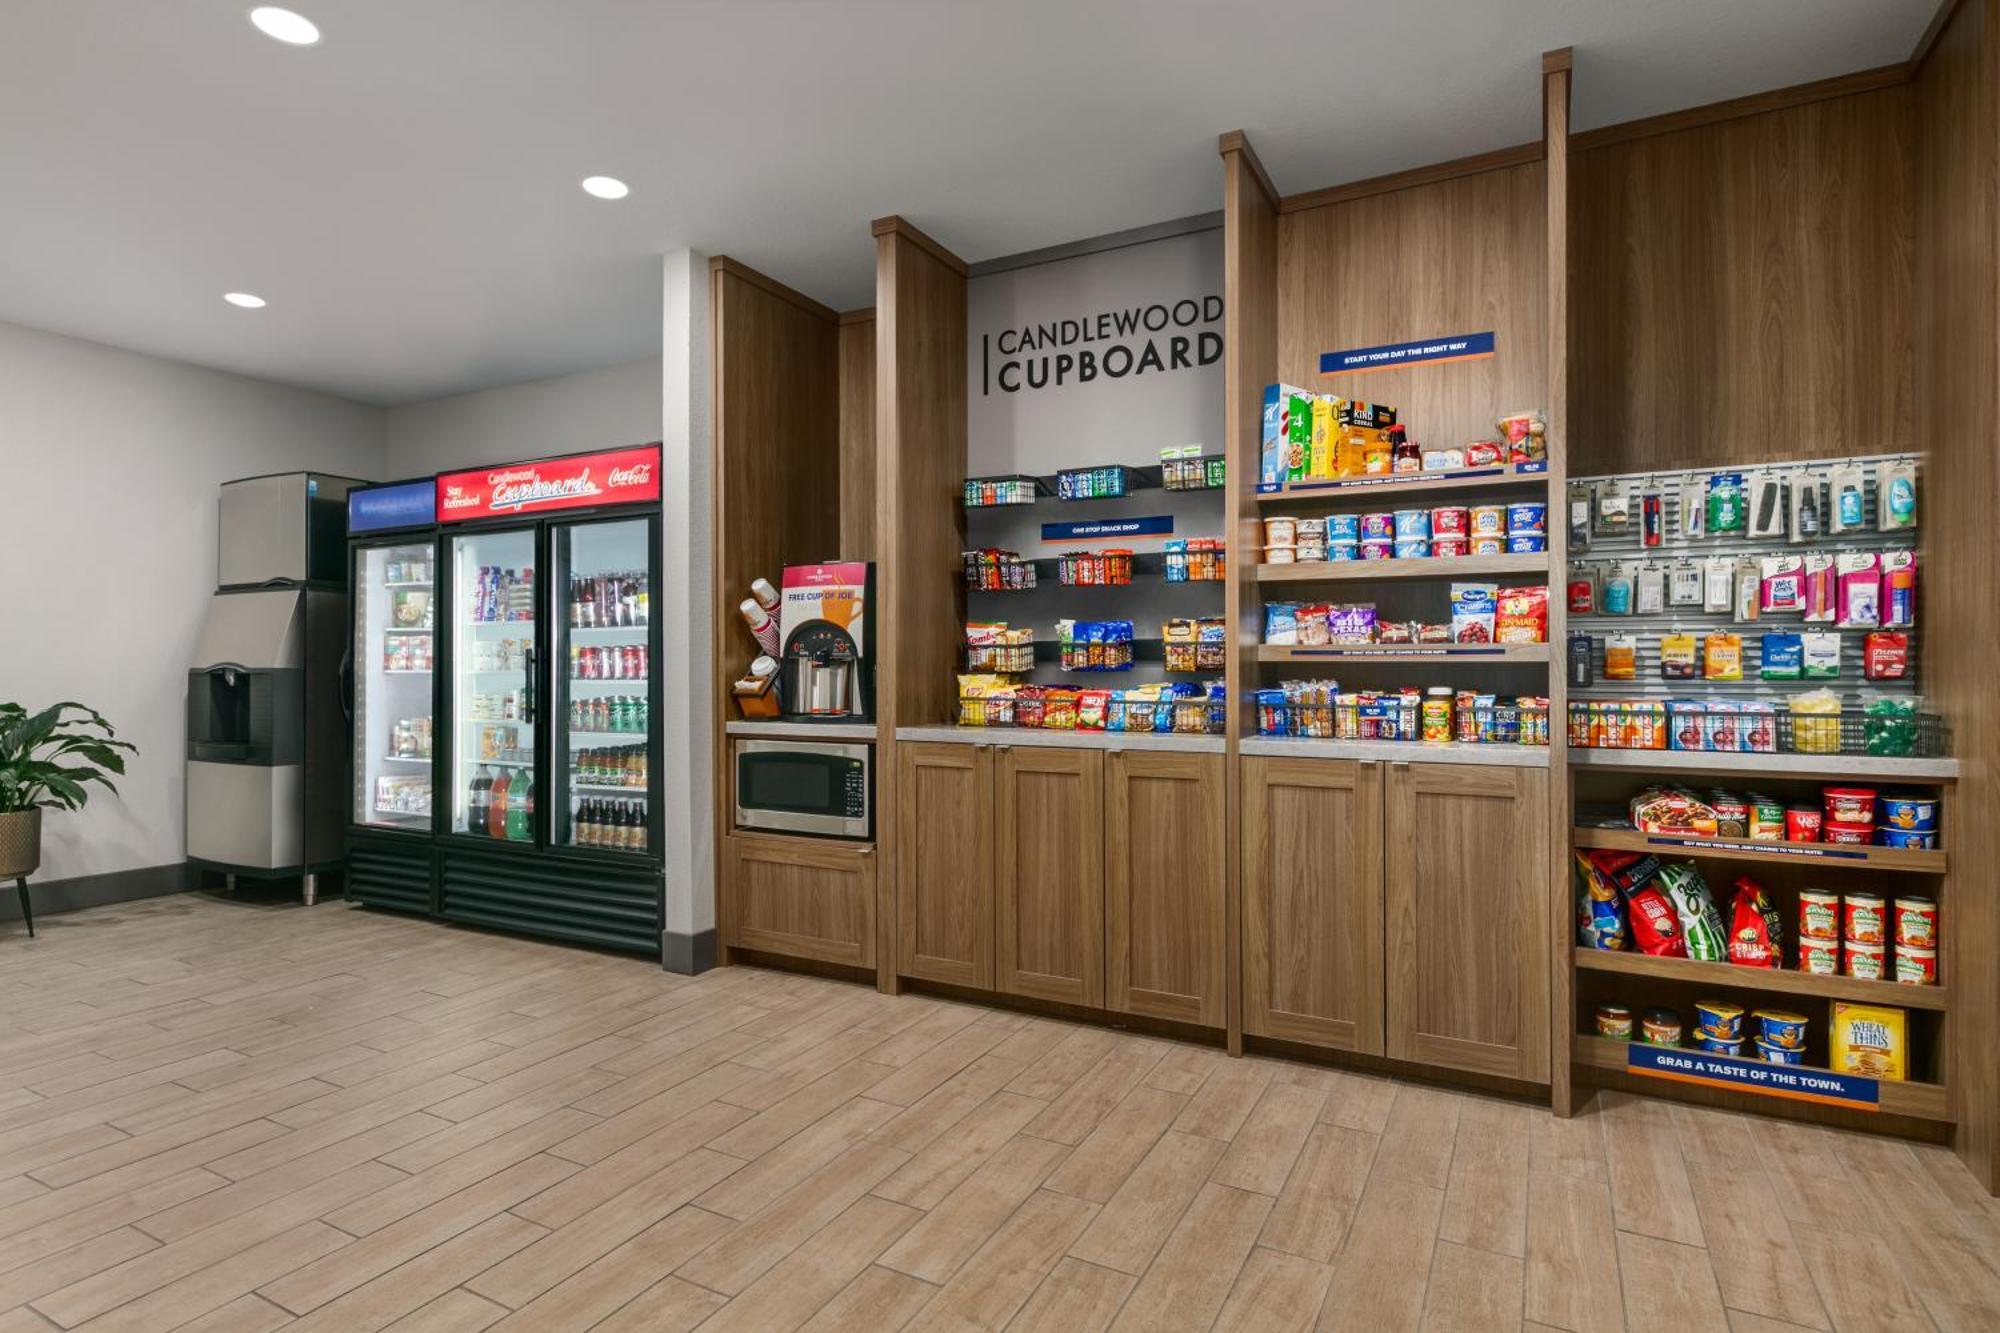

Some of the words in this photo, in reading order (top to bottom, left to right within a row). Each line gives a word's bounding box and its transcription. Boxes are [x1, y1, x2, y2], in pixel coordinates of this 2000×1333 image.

[998, 295, 1224, 355] CANDLEWOOD
[998, 331, 1224, 393] CUPBOARD
[1344, 353, 1367, 363] START
[1369, 351, 1389, 360] YOUR
[1390, 349, 1406, 358] DAY
[1407, 347, 1422, 356] THE
[1424, 344, 1448, 354] RIGHT
[1449, 342, 1467, 351] WAY
[1354, 409, 1373, 421] KIND
[608, 464, 652, 487] Coca-Cola
[447, 486, 463, 496] Stay
[490, 467, 602, 510] Cupboard
[444, 494, 480, 509] Refreshed
[789, 592, 805, 601] FREE
[806, 591, 823, 601] CUP
[825, 590, 834, 600] OF
[1850, 1021, 1889, 1035] WHEAT
[1851, 1031, 1889, 1048] THINS
[1657, 1055, 1692, 1069] GRAB
[1695, 1063, 1705, 1072] A
[1707, 1063, 1747, 1077] TASTE
[1750, 1069, 1769, 1080] OF
[1771, 1073, 1797, 1085] THE
[1800, 1077, 1845, 1092] TOWN.
